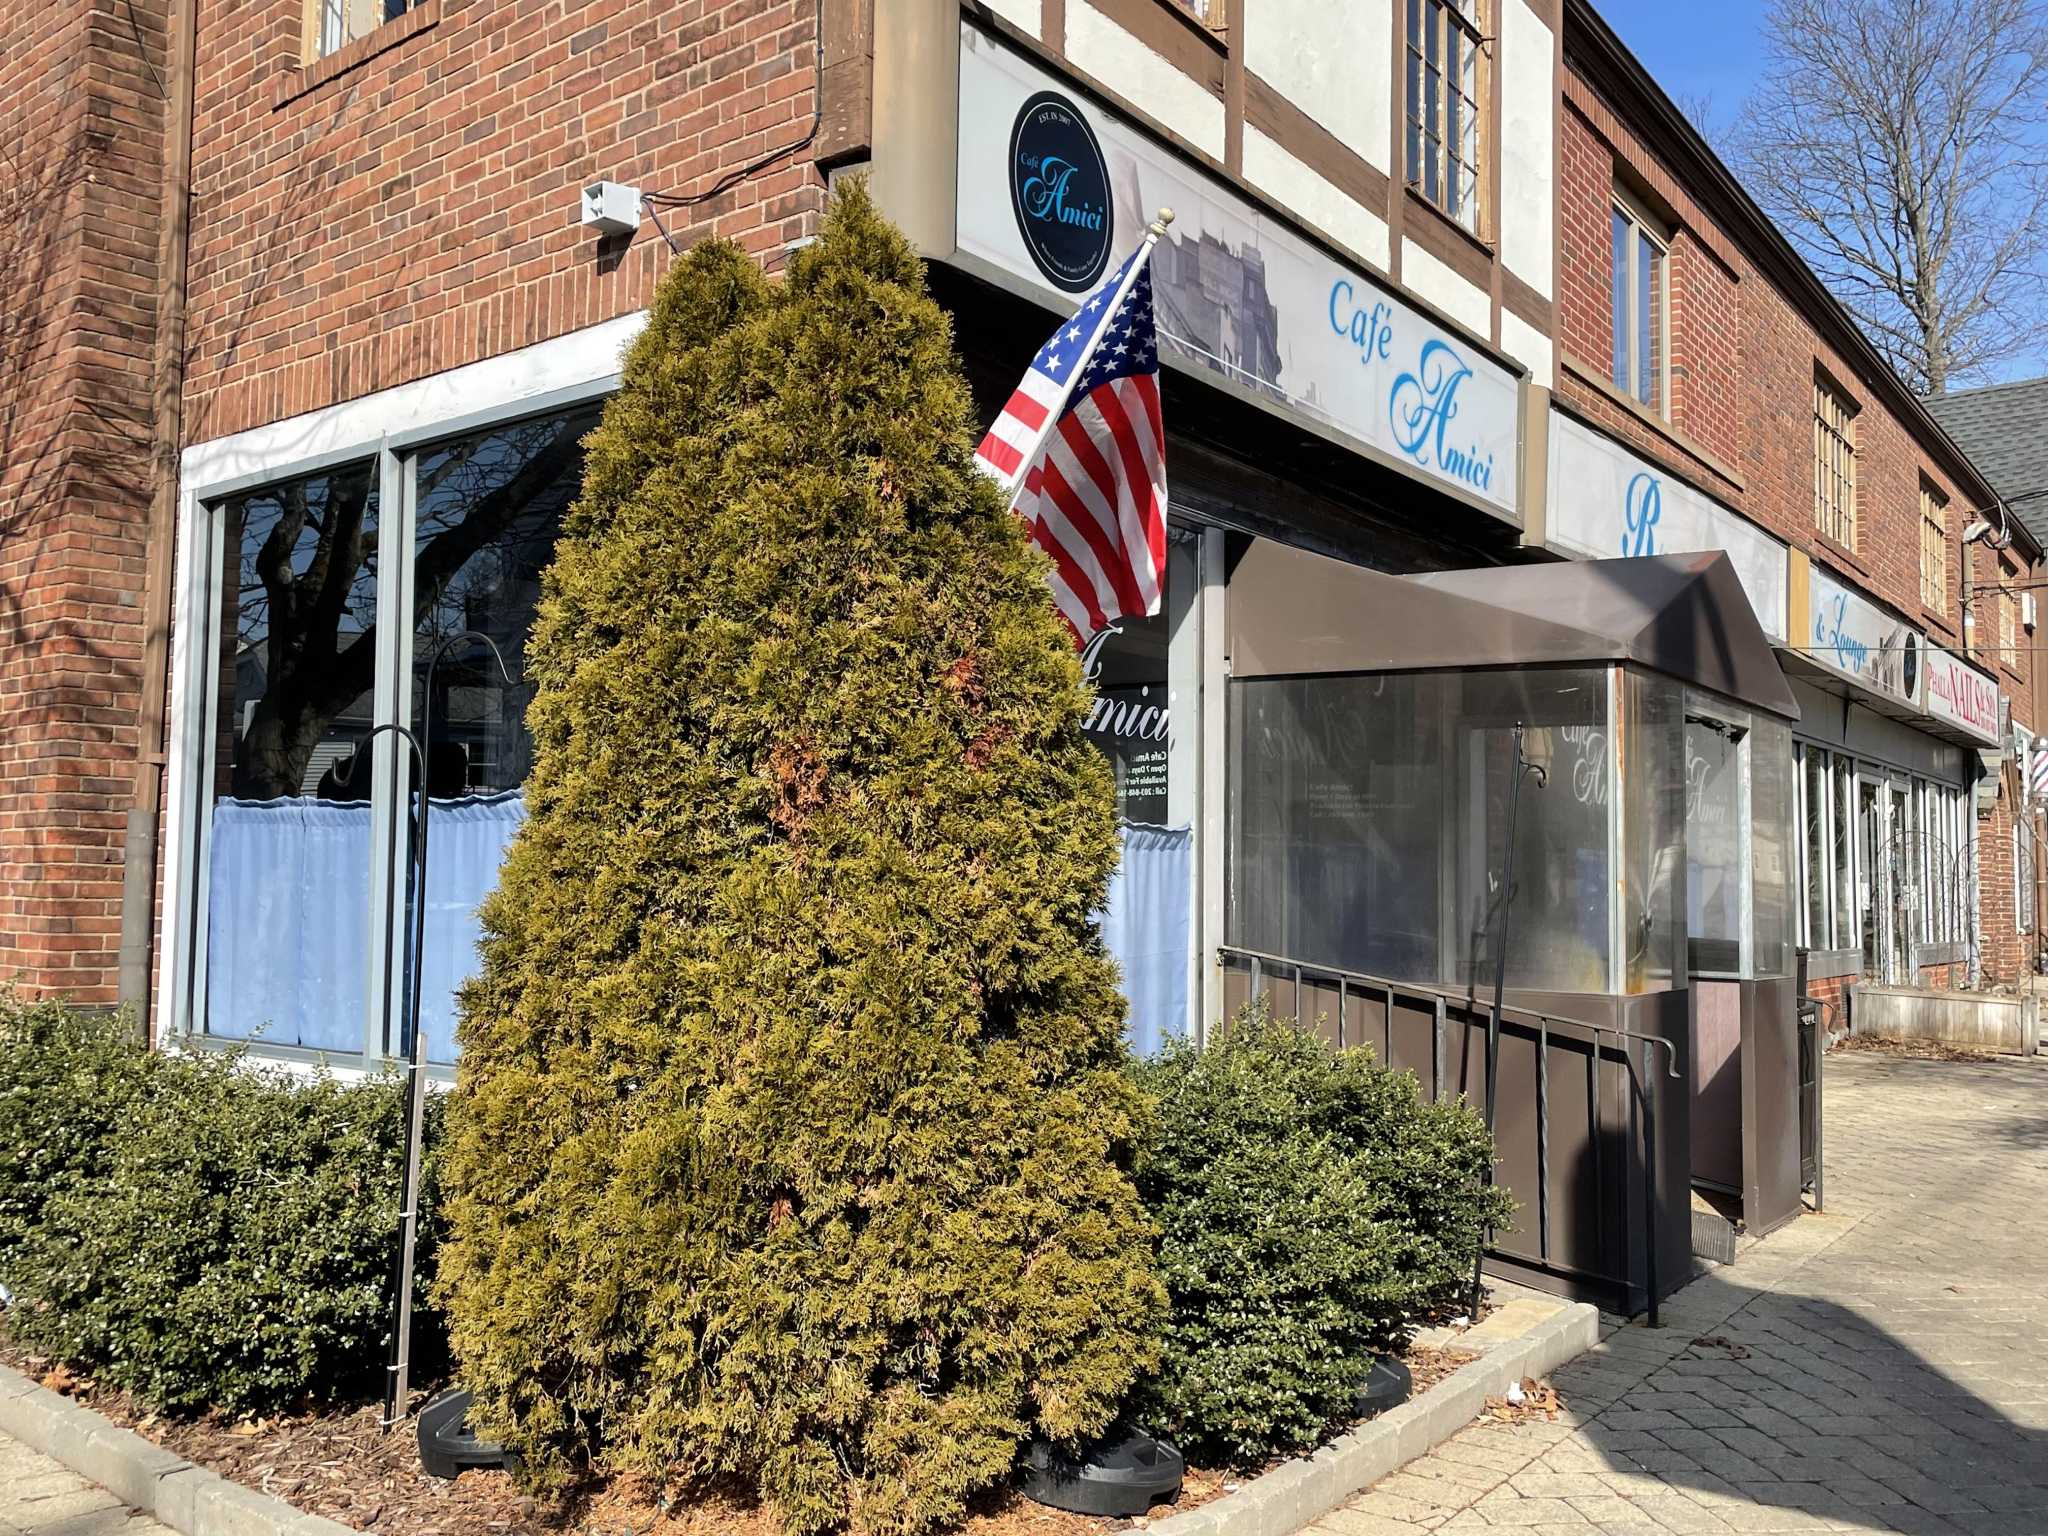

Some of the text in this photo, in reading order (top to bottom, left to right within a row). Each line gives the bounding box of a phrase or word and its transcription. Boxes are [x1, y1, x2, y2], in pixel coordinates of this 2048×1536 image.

[1024, 156, 1103, 230] Amici
[1330, 281, 1392, 364] Café
[1390, 339, 1493, 491] Amici
[1829, 593, 1867, 673] Lounge
[1948, 663, 1980, 727] NAILS
